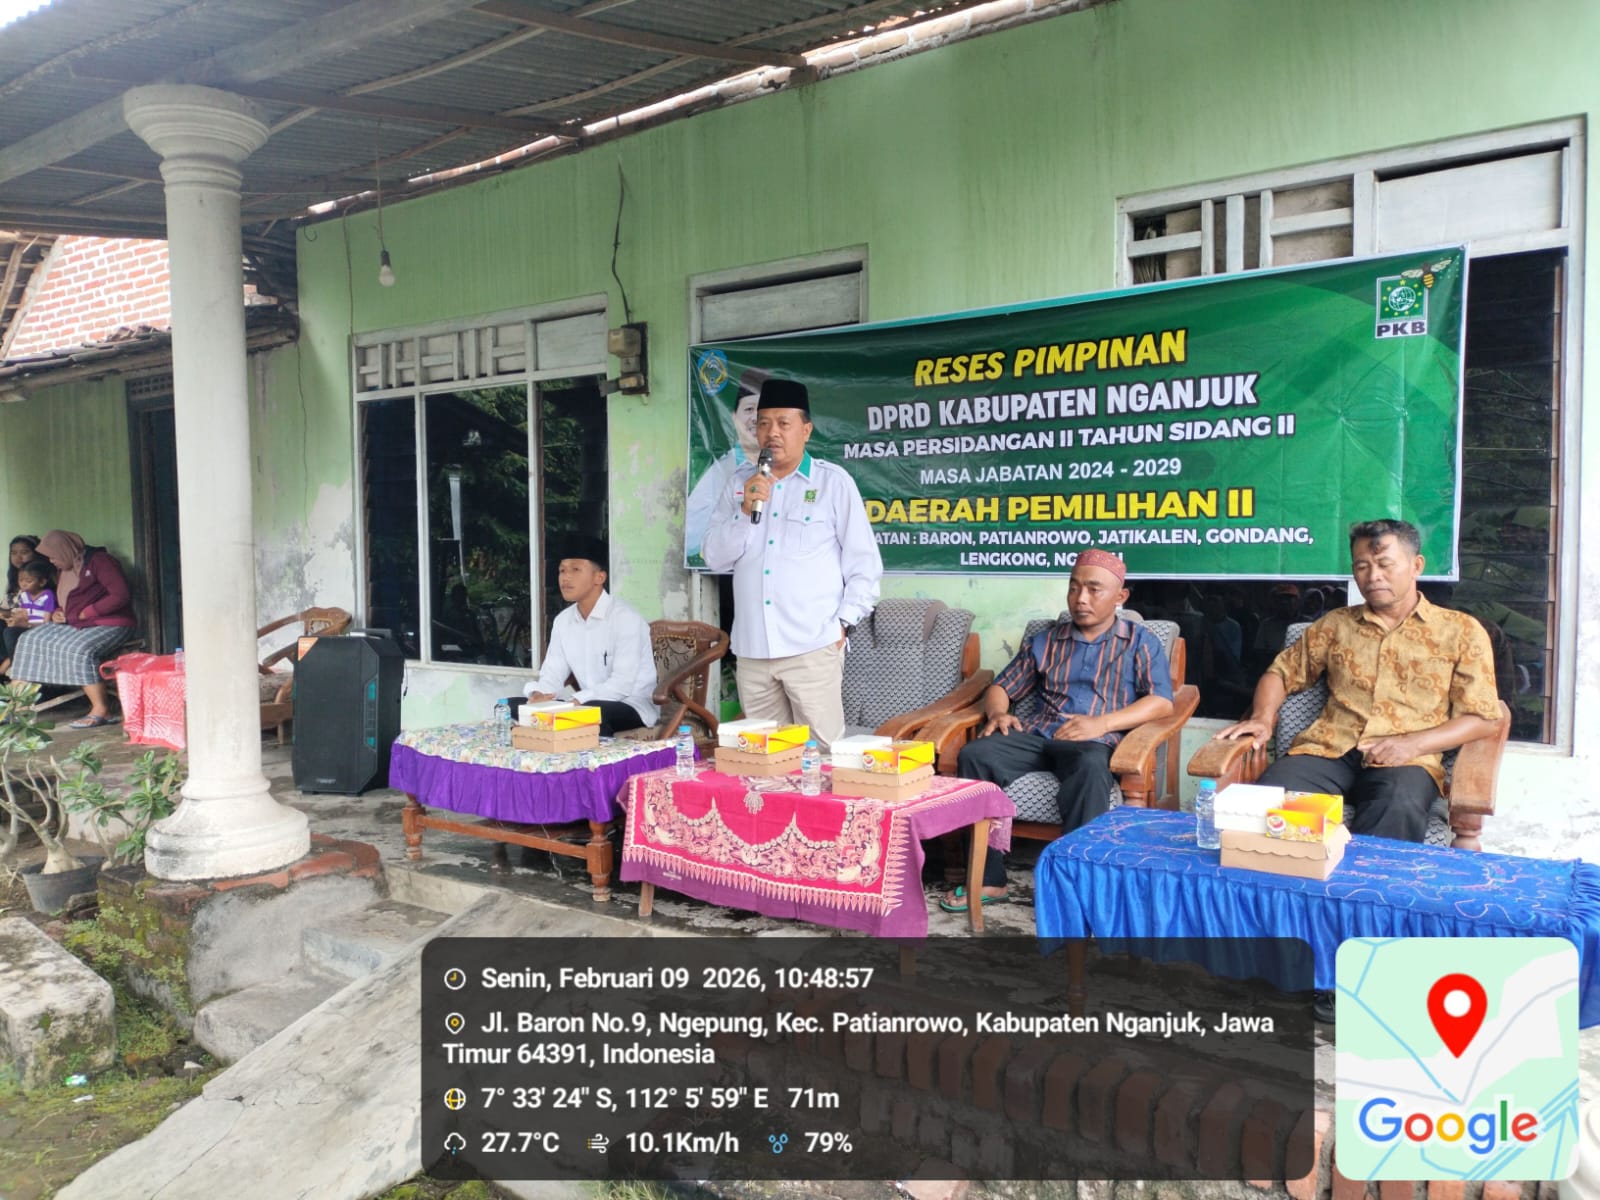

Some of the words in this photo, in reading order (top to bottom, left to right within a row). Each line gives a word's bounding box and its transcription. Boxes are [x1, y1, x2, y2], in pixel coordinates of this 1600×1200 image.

[1376, 321, 1426, 337] PKB
[914, 352, 1005, 387] RESES
[1014, 330, 1186, 377] PIMPINAN
[867, 402, 931, 431] DPRD
[938, 387, 1096, 426] KABUPATEN
[1107, 374, 1258, 414] NGANJUK
[844, 442, 899, 459] MASA
[903, 431, 1055, 456] PERSIDANGAN
[1060, 429, 1073, 447] II
[1078, 423, 1163, 447] TAHUN
[1168, 415, 1271, 441] SIDANG
[1277, 414, 1295, 435] II
[920, 468, 971, 485] MASA
[976, 464, 1063, 483] JABATAN
[1068, 461, 1114, 479] 2024
[1132, 457, 1182, 477] 2029
[866, 497, 999, 523] DAERAH
[1008, 489, 1217, 521] PEMILIHAN
[1228, 488, 1253, 517] II
[919, 531, 976, 547] BARON,
[979, 530, 1095, 546] PATIANROWO,
[1098, 528, 1202, 545] JATIKALEN,
[1206, 527, 1314, 545] GONDANG,
[960, 551, 1051, 568] LENGKONG,
